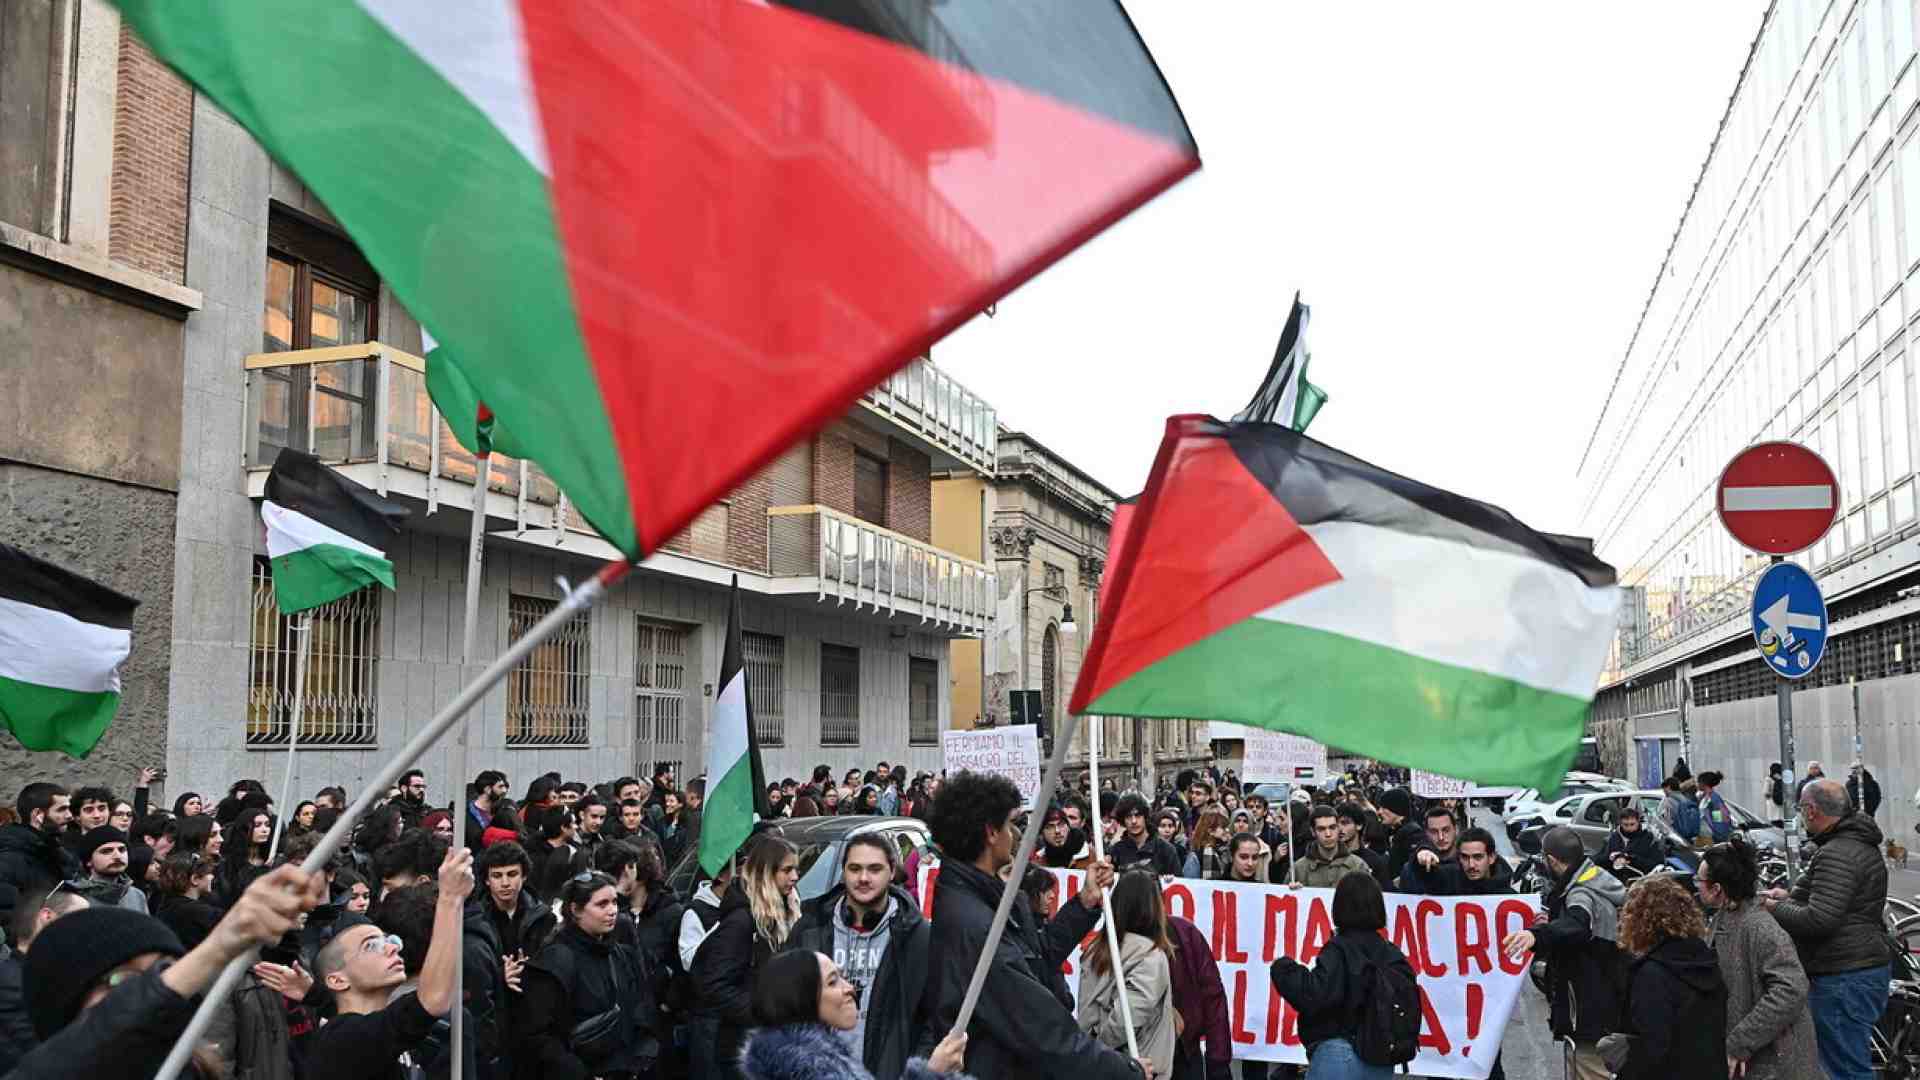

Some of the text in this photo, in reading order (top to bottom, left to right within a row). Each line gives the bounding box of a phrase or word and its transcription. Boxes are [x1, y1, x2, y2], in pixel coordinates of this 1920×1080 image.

[945, 734, 1025, 753] FERMIAMO IL
[946, 750, 1027, 769] MASSACRO DEL
[1416, 780, 1466, 794] LIBERA!
[1212, 890, 1248, 963] IL
[1263, 893, 1536, 978] MAACRO
[834, 949, 881, 968] OPEN
